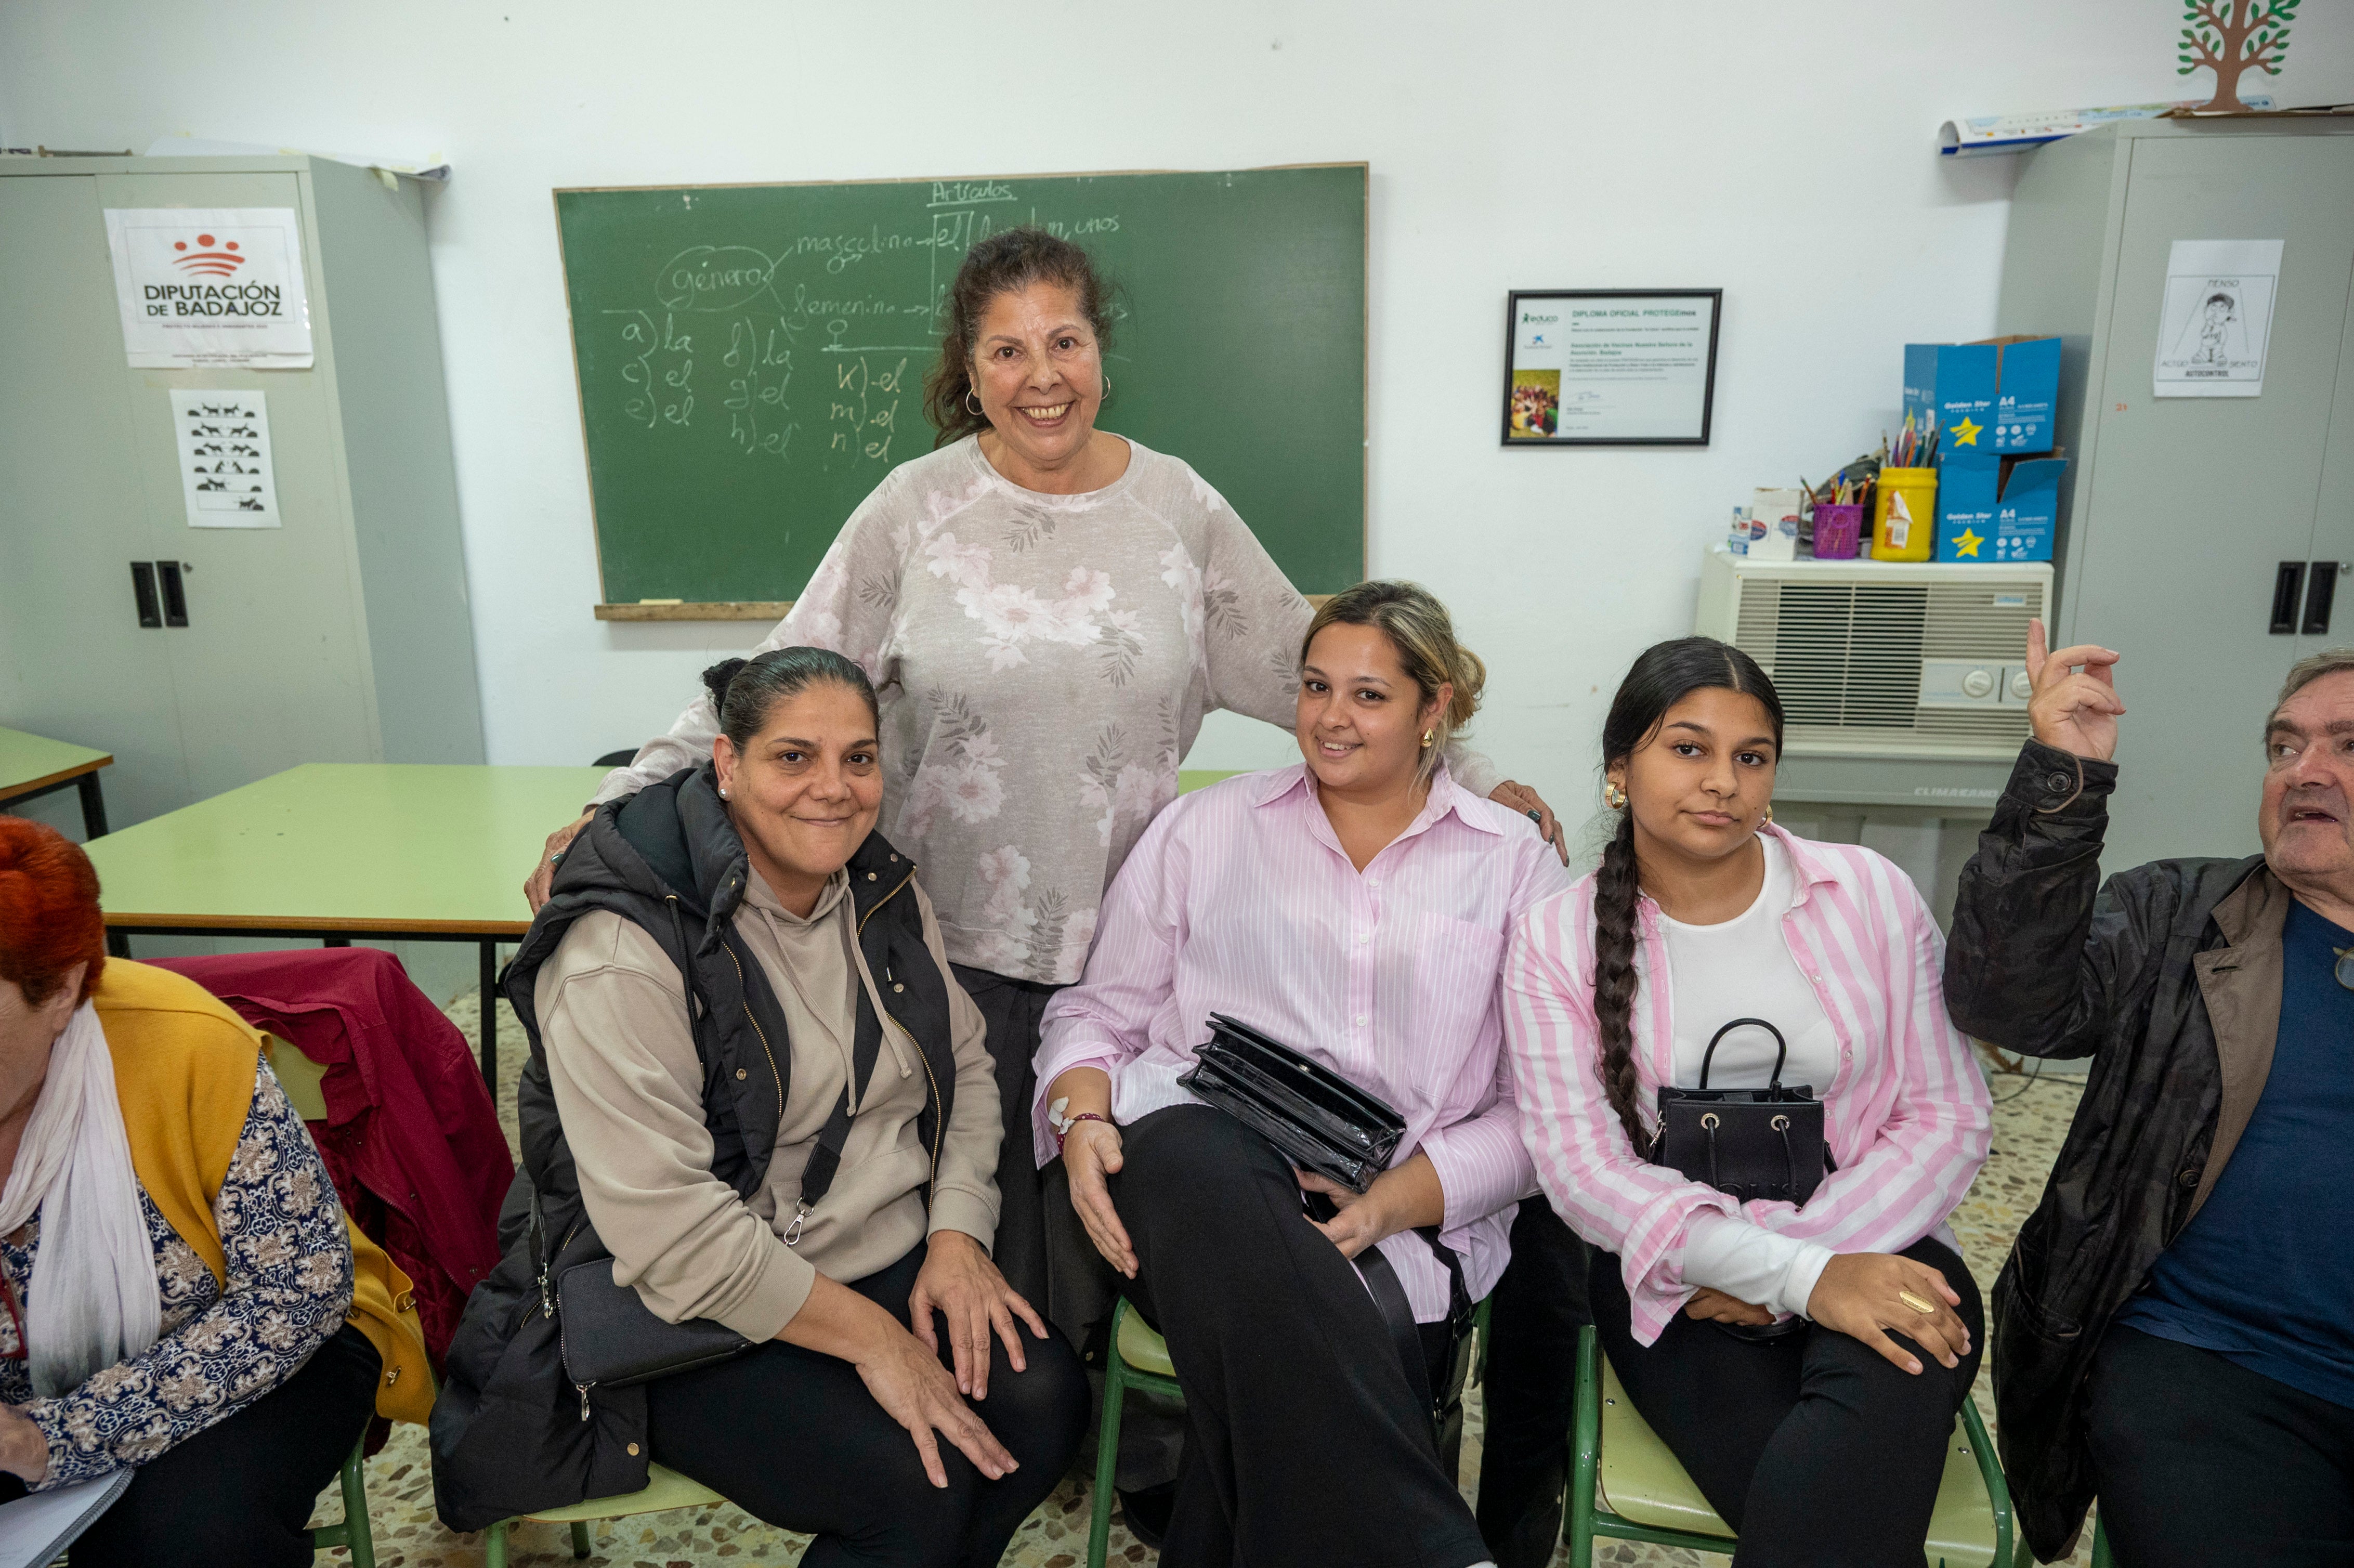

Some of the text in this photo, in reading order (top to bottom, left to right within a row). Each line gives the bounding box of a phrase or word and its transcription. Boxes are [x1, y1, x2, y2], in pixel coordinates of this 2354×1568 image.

[933, 180, 1013, 203] Artículos
[797, 224, 912, 255] masculino
[1074, 215, 1120, 234] unos
[144, 280, 281, 300] DIPUTACIÓN
[667, 261, 762, 308] género
[147, 301, 282, 316] DE BADAJOZ
[787, 284, 896, 330] femenino
[622, 310, 694, 358] a) la
[762, 329, 794, 371] la
[666, 359, 692, 393] el
[664, 395, 694, 426] el
[1999, 395, 2016, 406] A4
[2000, 508, 2016, 518] A4
